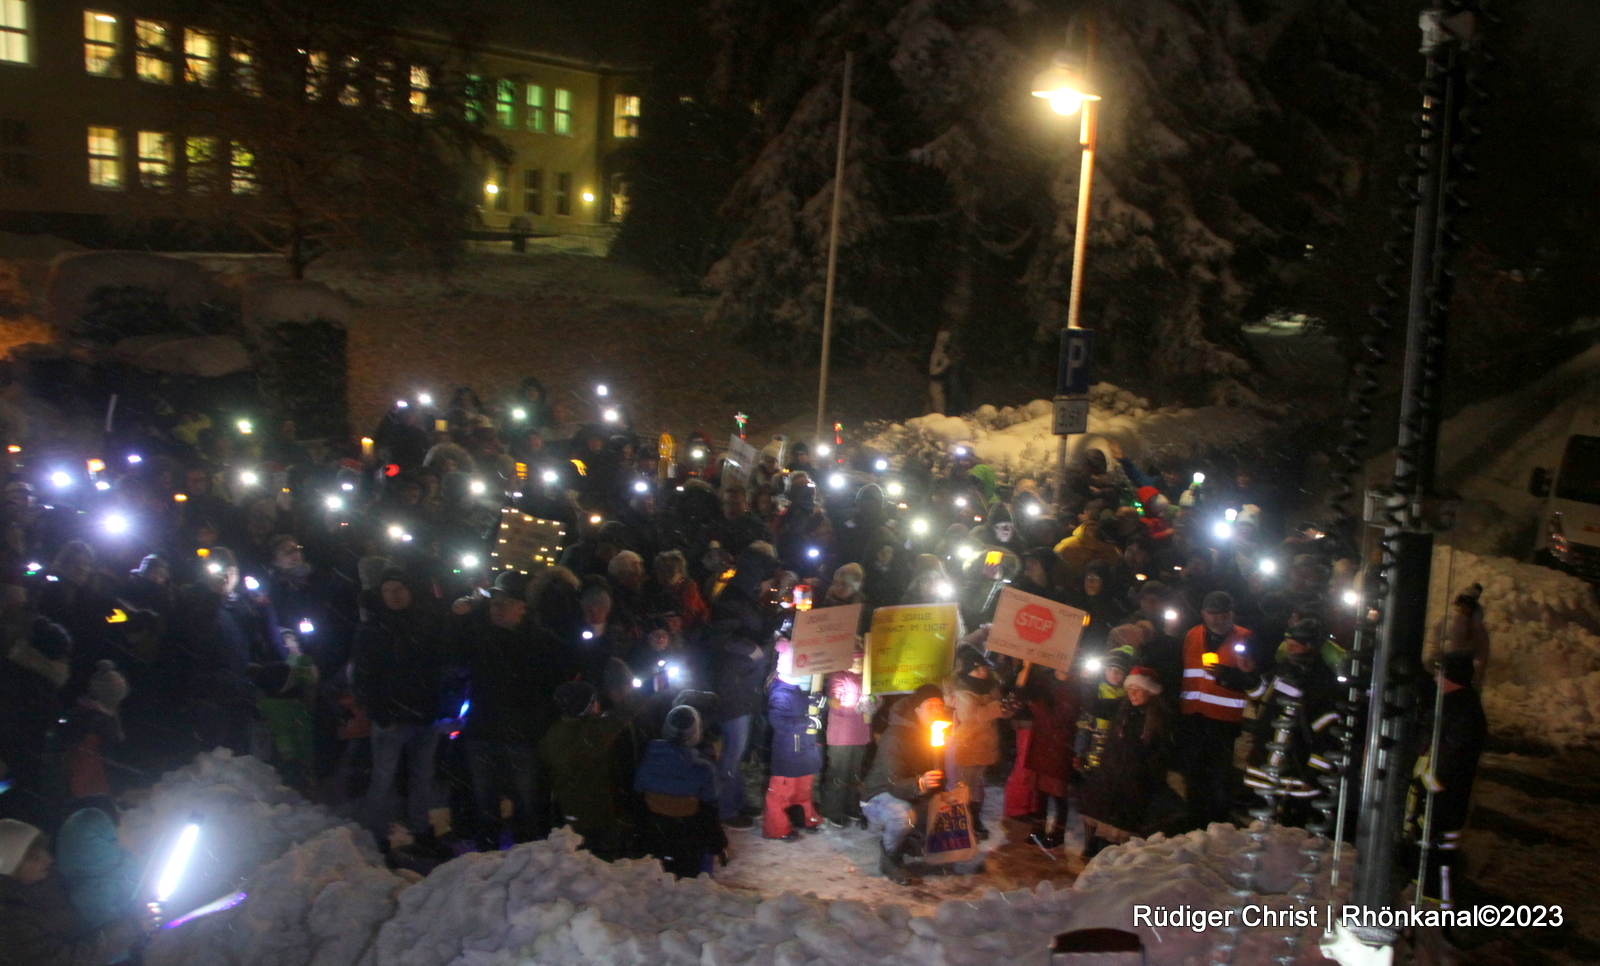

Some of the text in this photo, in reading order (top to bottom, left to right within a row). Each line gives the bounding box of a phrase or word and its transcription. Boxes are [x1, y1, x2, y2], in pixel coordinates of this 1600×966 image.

[1066, 338, 1086, 387] P
[924, 622, 949, 632] LICHT
[1017, 612, 1053, 631] STOP
